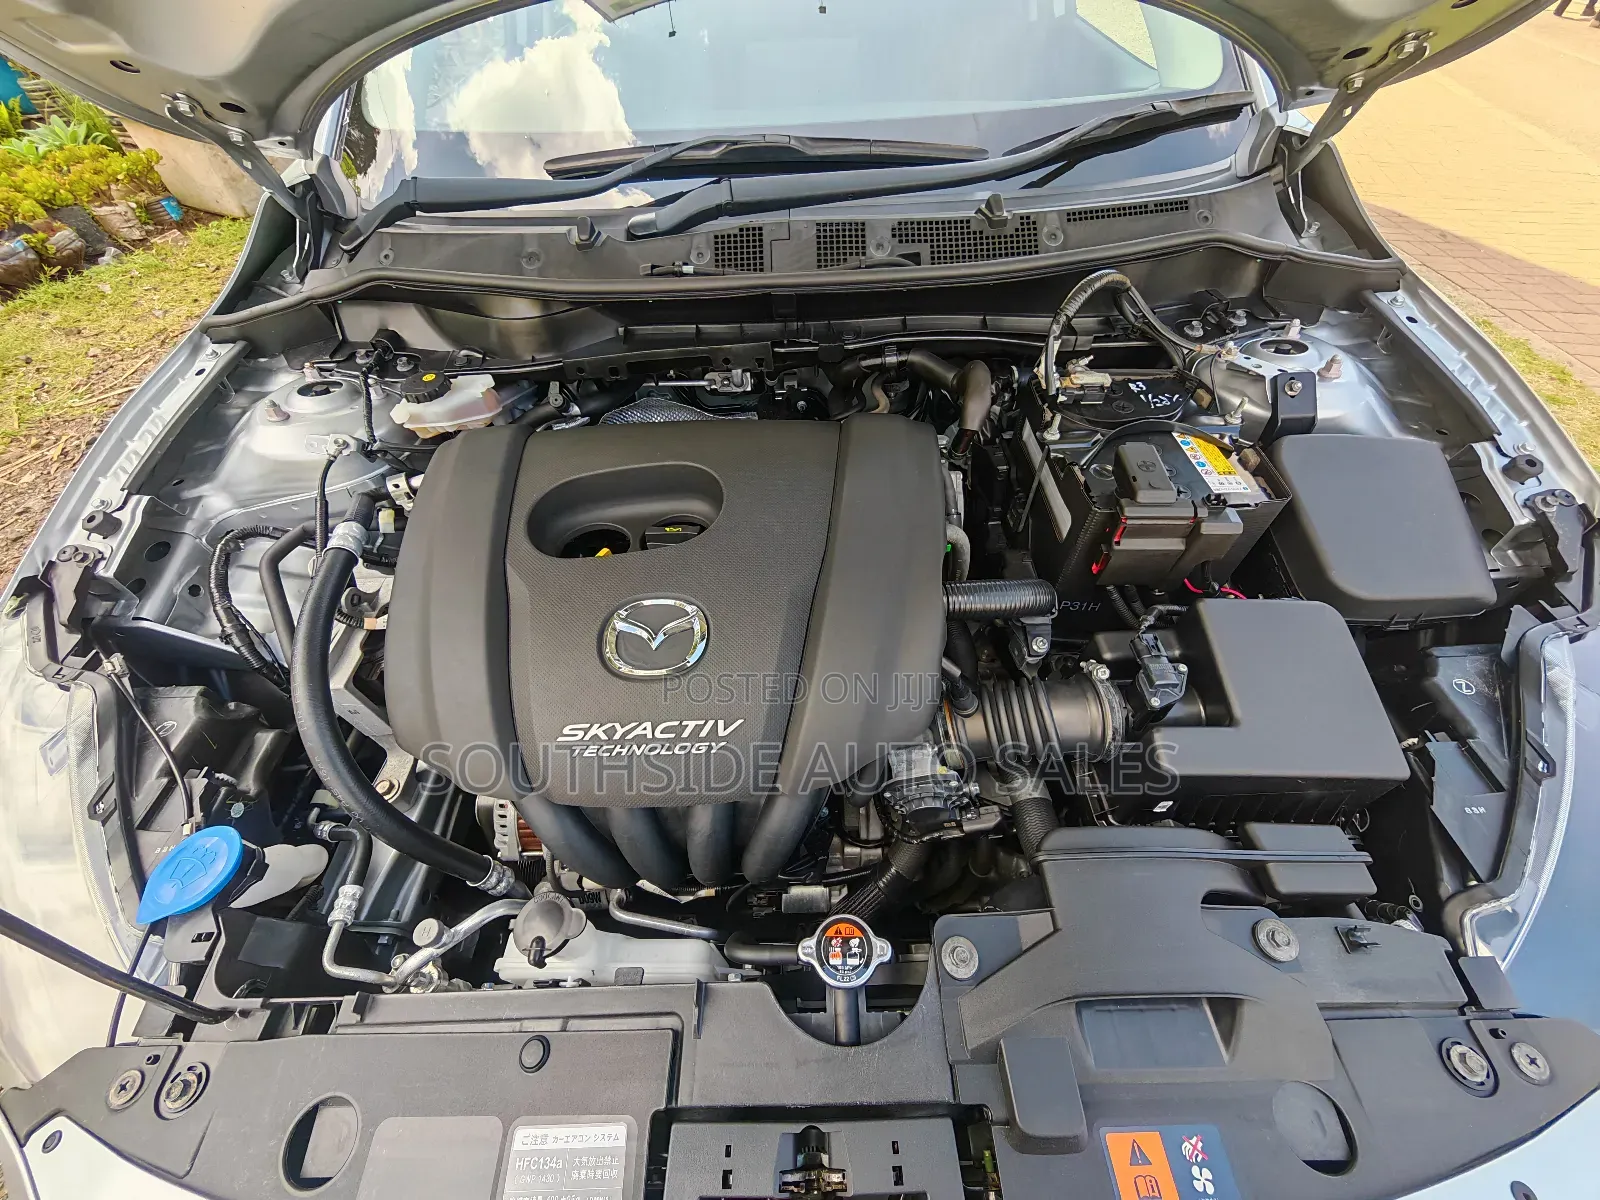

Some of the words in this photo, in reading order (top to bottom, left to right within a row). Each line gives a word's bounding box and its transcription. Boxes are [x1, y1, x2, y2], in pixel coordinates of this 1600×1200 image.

[1060, 600, 1102, 611] P31H
[555, 718, 746, 742] SKYACTIV
[571, 741, 729, 757] TECHNOLOGY
[521, 1133, 550, 1146] ご注意
[552, 1134, 591, 1144] カーエアコン
[593, 1132, 620, 1142] システム
[515, 1156, 563, 1171] HFC134a
[572, 1155, 620, 1167] 大気放出禁止
